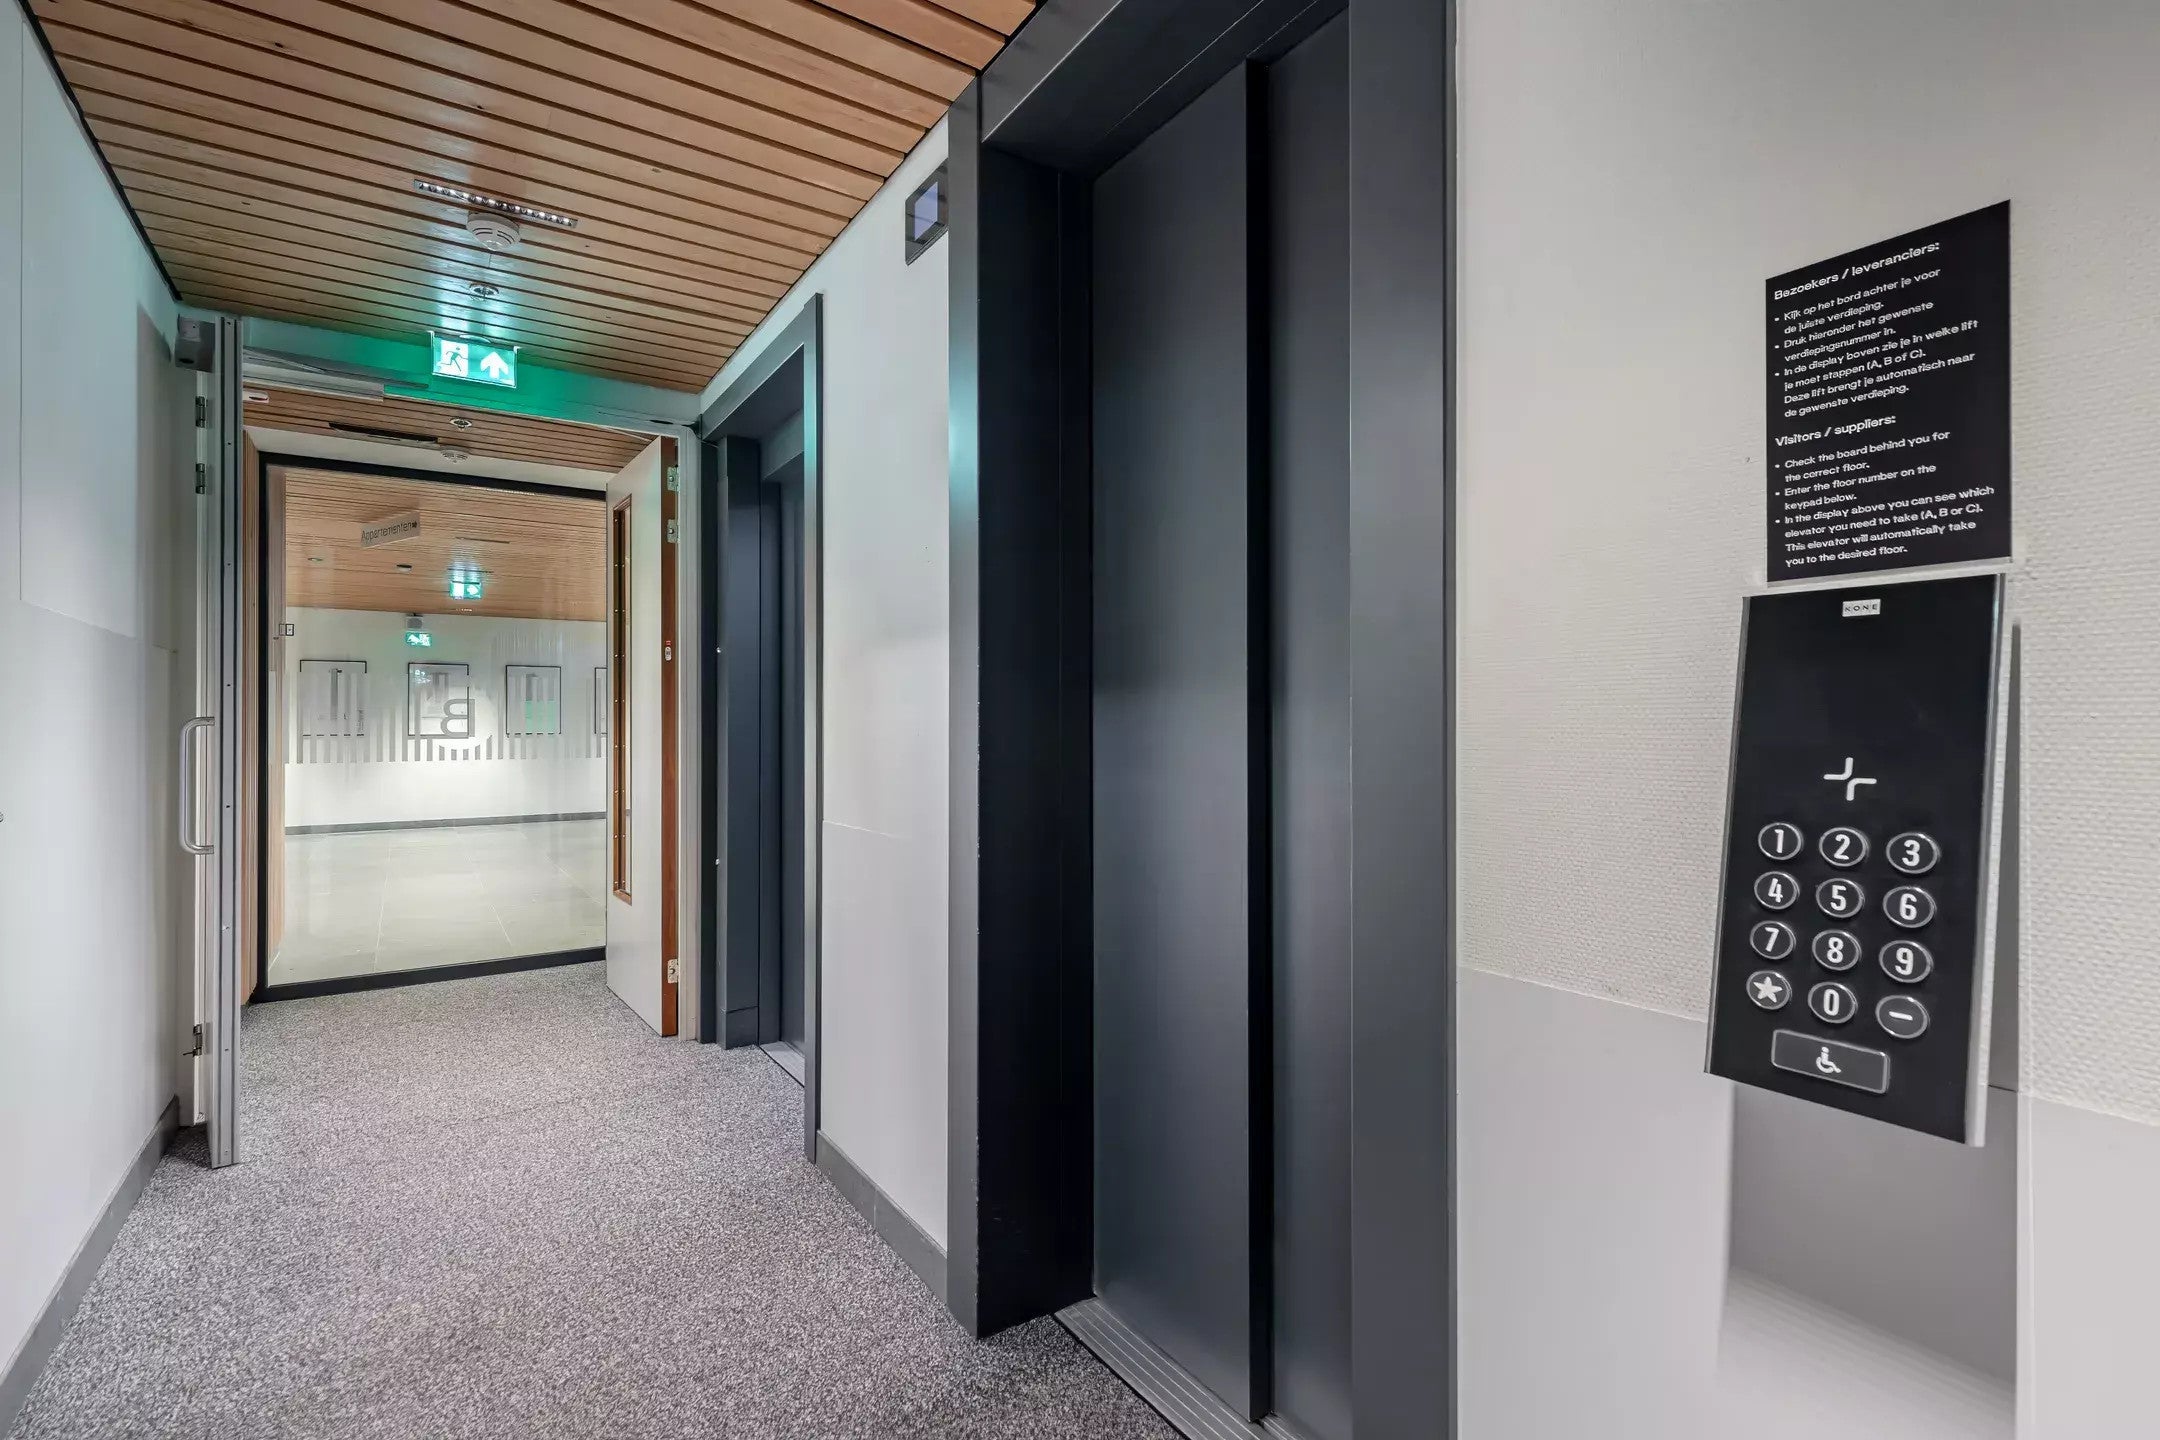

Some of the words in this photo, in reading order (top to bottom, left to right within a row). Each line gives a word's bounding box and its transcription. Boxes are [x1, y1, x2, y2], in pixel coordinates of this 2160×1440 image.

[1774, 274, 1838, 300] Bezoekers
[1851, 242, 1939, 276] leveranciers:
[1784, 309, 1801, 321] Kijk
[1803, 306, 1816, 315] op
[1817, 299, 1835, 311] het
[1836, 290, 1861, 305] bord
[1863, 281, 1898, 297] achter
[1901, 277, 1911, 288] je
[1913, 269, 1940, 282] voor
[1784, 325, 1796, 334] de
[1798, 317, 1825, 332] juiste
[1827, 301, 1884, 322] verdieping.
[1784, 336, 1807, 348] Druk
[1808, 323, 1856, 341] hieronder
[1858, 317, 1876, 328] het
[1878, 302, 1933, 324] gewenste
[1784, 330, 1881, 362] verdiepingsnummer
[1883, 327, 1896, 336] in.
[1784, 368, 1792, 376] In
[1794, 364, 1807, 373] de
[1808, 355, 1844, 370] display
[1846, 346, 1879, 360] boven
[1881, 341, 1898, 351] zie
[1900, 338, 1910, 349] je
[1912, 334, 1923, 343] in
[1925, 326, 1959, 340] welke
[1961, 319, 1978, 331] lift
[1784, 381, 1794, 392] je
[1795, 374, 1820, 387] moet
[1822, 364, 1865, 381] stappen
[1866, 359, 1882, 370] (A,
[1883, 356, 1892, 366] B
[1894, 352, 1907, 363] of
[1909, 348, 1926, 359] C).
[1784, 392, 1810, 404] Deze
[1811, 387, 1825, 397] lift
[1827, 379, 1861, 394] brengt
[1863, 376, 1874, 387] je
[1875, 359, 1945, 382] automatisch
[1947, 353, 1975, 366] naar
[1784, 409, 1797, 418] de
[1798, 398, 1848, 416] gewenste
[1850, 384, 1909, 403] verdieping.
[1774, 431, 1821, 446] Visitors
[1834, 415, 1896, 435] suppliers:
[1784, 455, 1816, 468] Check
[1818, 453, 1835, 462] the
[1836, 445, 1868, 459] board
[1869, 438, 1905, 453] behind
[1907, 435, 1930, 447] you
[1931, 431, 1950, 441] for
[1784, 473, 1801, 482] the
[1802, 466, 1840, 479] correct
[1842, 462, 1870, 472] floor.
[1784, 486, 1811, 496] Enter
[1813, 482, 1830, 491] the
[1831, 478, 1856, 488] floor
[1858, 471, 1898, 484] number
[1900, 468, 1915, 477] on
[1917, 464, 1936, 474] the
[1784, 496, 1822, 510] keypad
[1823, 493, 1857, 504] below.
[1784, 516, 1793, 524] In
[1794, 514, 1811, 523] the
[1813, 509, 1849, 520] display
[1851, 503, 1885, 514] above
[1887, 499, 1909, 511] you
[1910, 496, 1933, 506] can
[1934, 492, 1956, 502] see
[1958, 485, 1994, 499] which
[1784, 526, 1826, 538] elevator
[1828, 523, 1848, 534] you
[1849, 517, 1877, 529] need
[1878, 517, 1891, 525] to
[1892, 513, 1918, 523] take
[1920, 509, 1937, 520] (A,
[1938, 507, 1948, 517] B
[1950, 507, 1963, 516] or
[1965, 503, 1983, 513] C).
[1785, 542, 1806, 552] This
[1807, 537, 1850, 549] elevator
[1851, 533, 1868, 543] will
[1869, 524, 1945, 541] automatically
[1948, 520, 1976, 532] take
[1785, 557, 1804, 568] you
[1818, 553, 1836, 562] the
[1837, 547, 1877, 560] desired
[1878, 545, 1908, 555] floor.
[1844, 604, 1878, 612] KONE
[1774, 829, 1784, 853] 1
[1834, 834, 1850, 860] 2
[1902, 840, 1920, 867] 3
[1768, 878, 1783, 903] 4
[1831, 885, 1847, 911] 5
[1899, 894, 1918, 921] 6
[1765, 927, 1779, 952] 7
[1826, 937, 1844, 964] 8
[1895, 947, 1914, 975] 9
[1823, 989, 1840, 1016] 0
